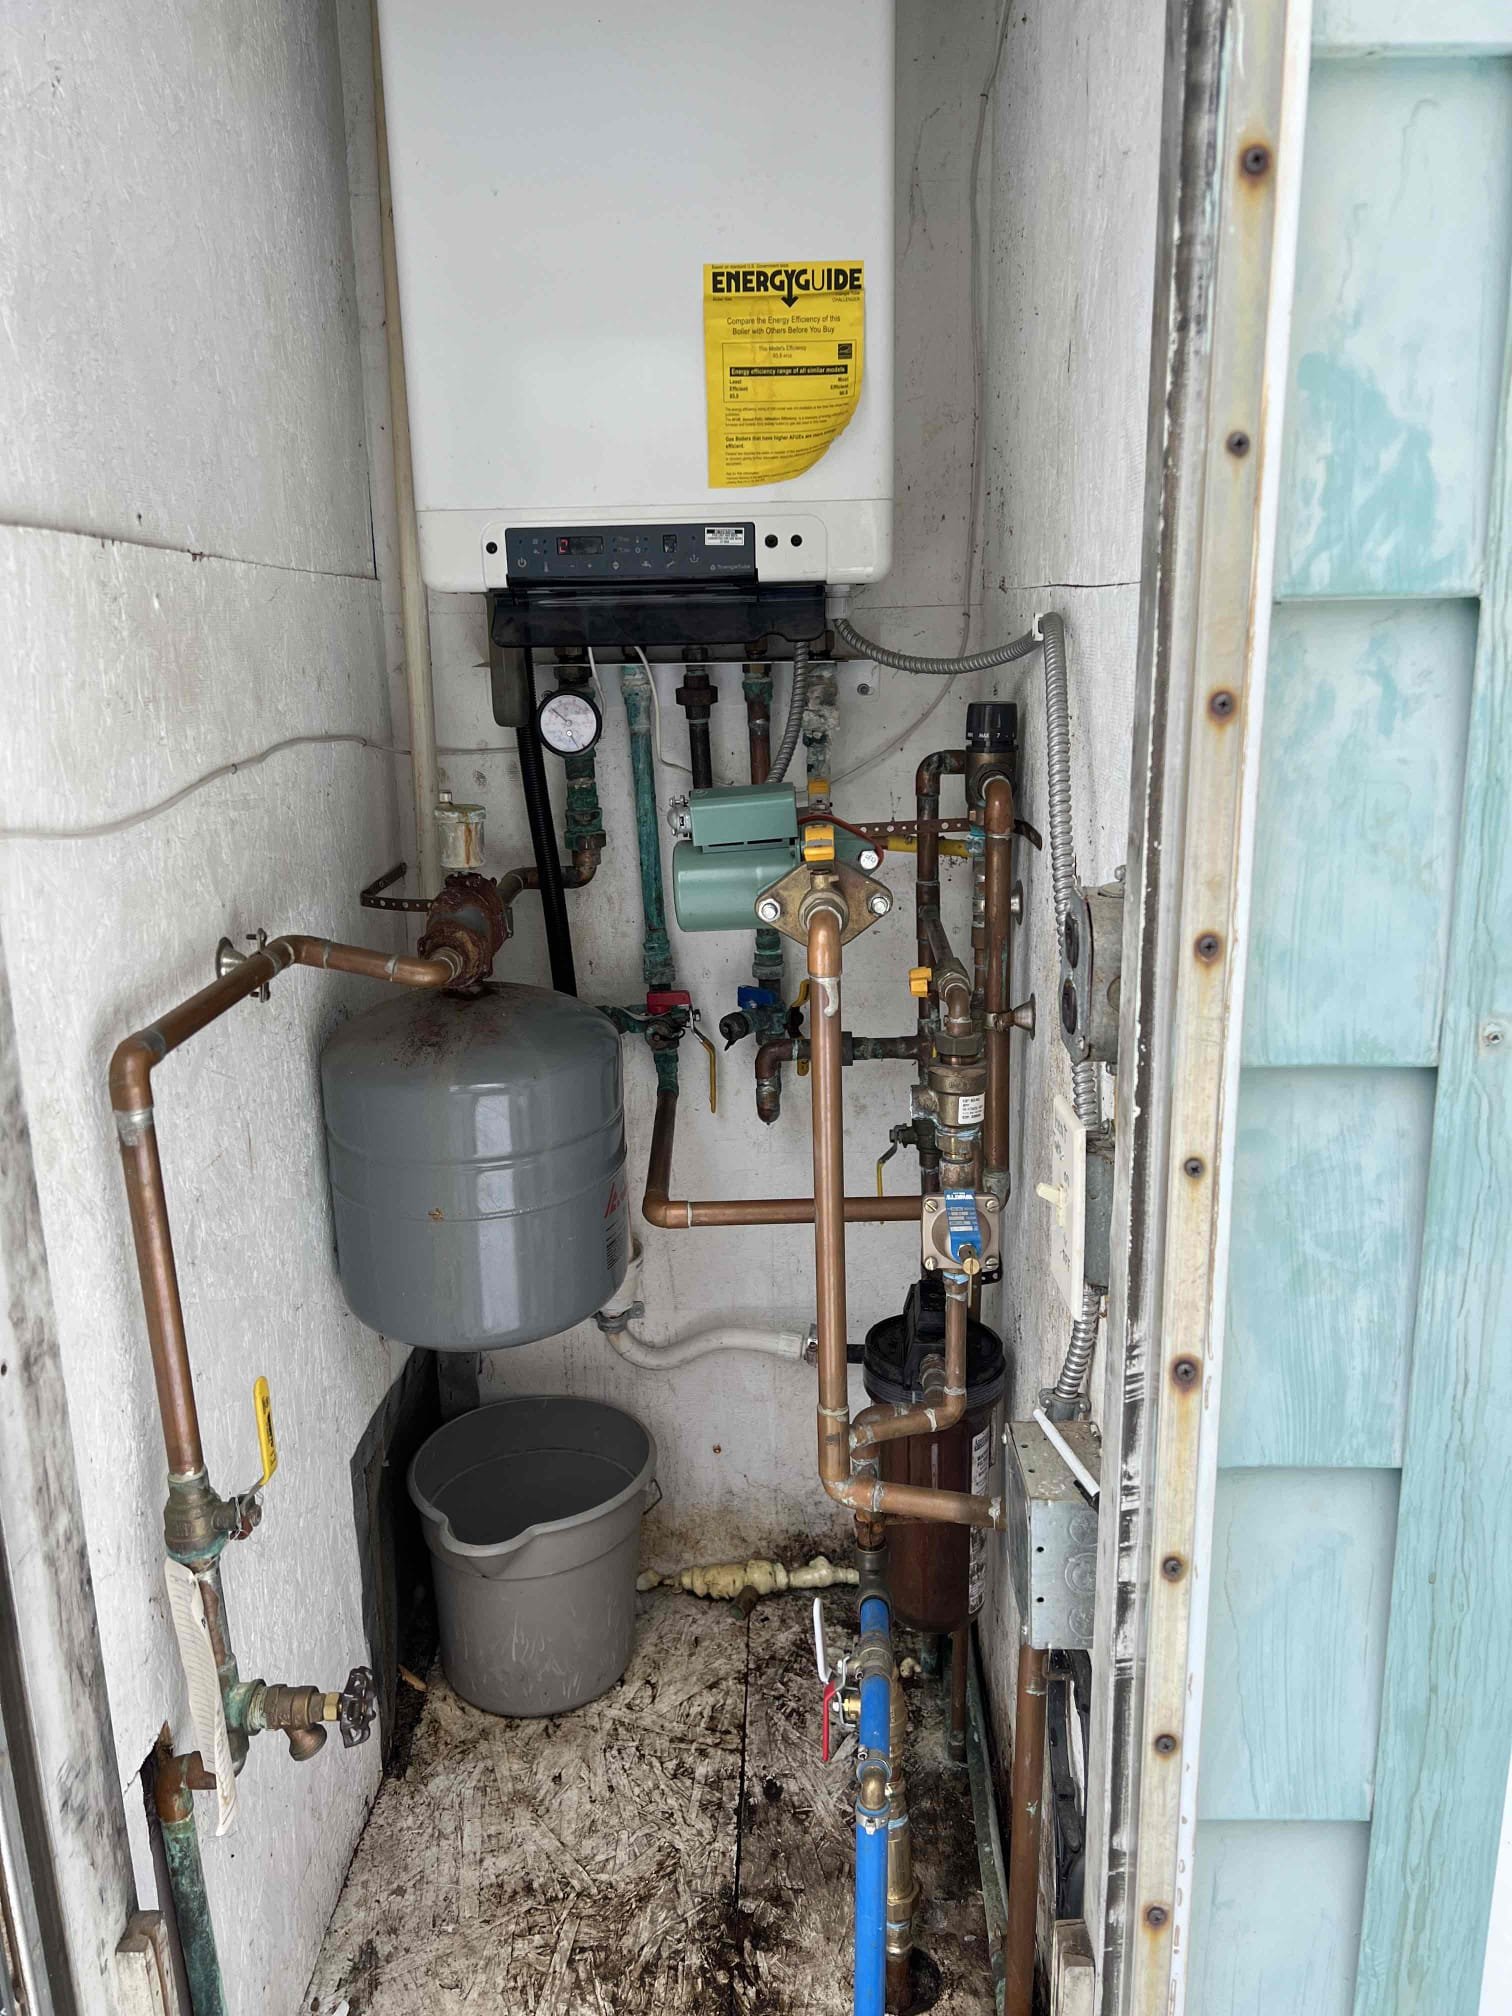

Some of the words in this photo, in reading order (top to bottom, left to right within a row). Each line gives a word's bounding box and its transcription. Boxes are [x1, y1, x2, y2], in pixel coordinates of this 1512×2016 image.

[712, 268, 862, 292] ENERGYGUIDE
[727, 317, 755, 325] Compare
[757, 316, 766, 324] the
[768, 316, 789, 325] Energy
[791, 315, 820, 324] Efficiency
[830, 314, 840, 322] this
[732, 327, 750, 335] Boiler
[766, 326, 786, 334] Others
[788, 326, 808, 334] Before
[810, 325, 821, 333] You
[823, 325, 834, 334] Buy
[731, 368, 749, 376] Energy
